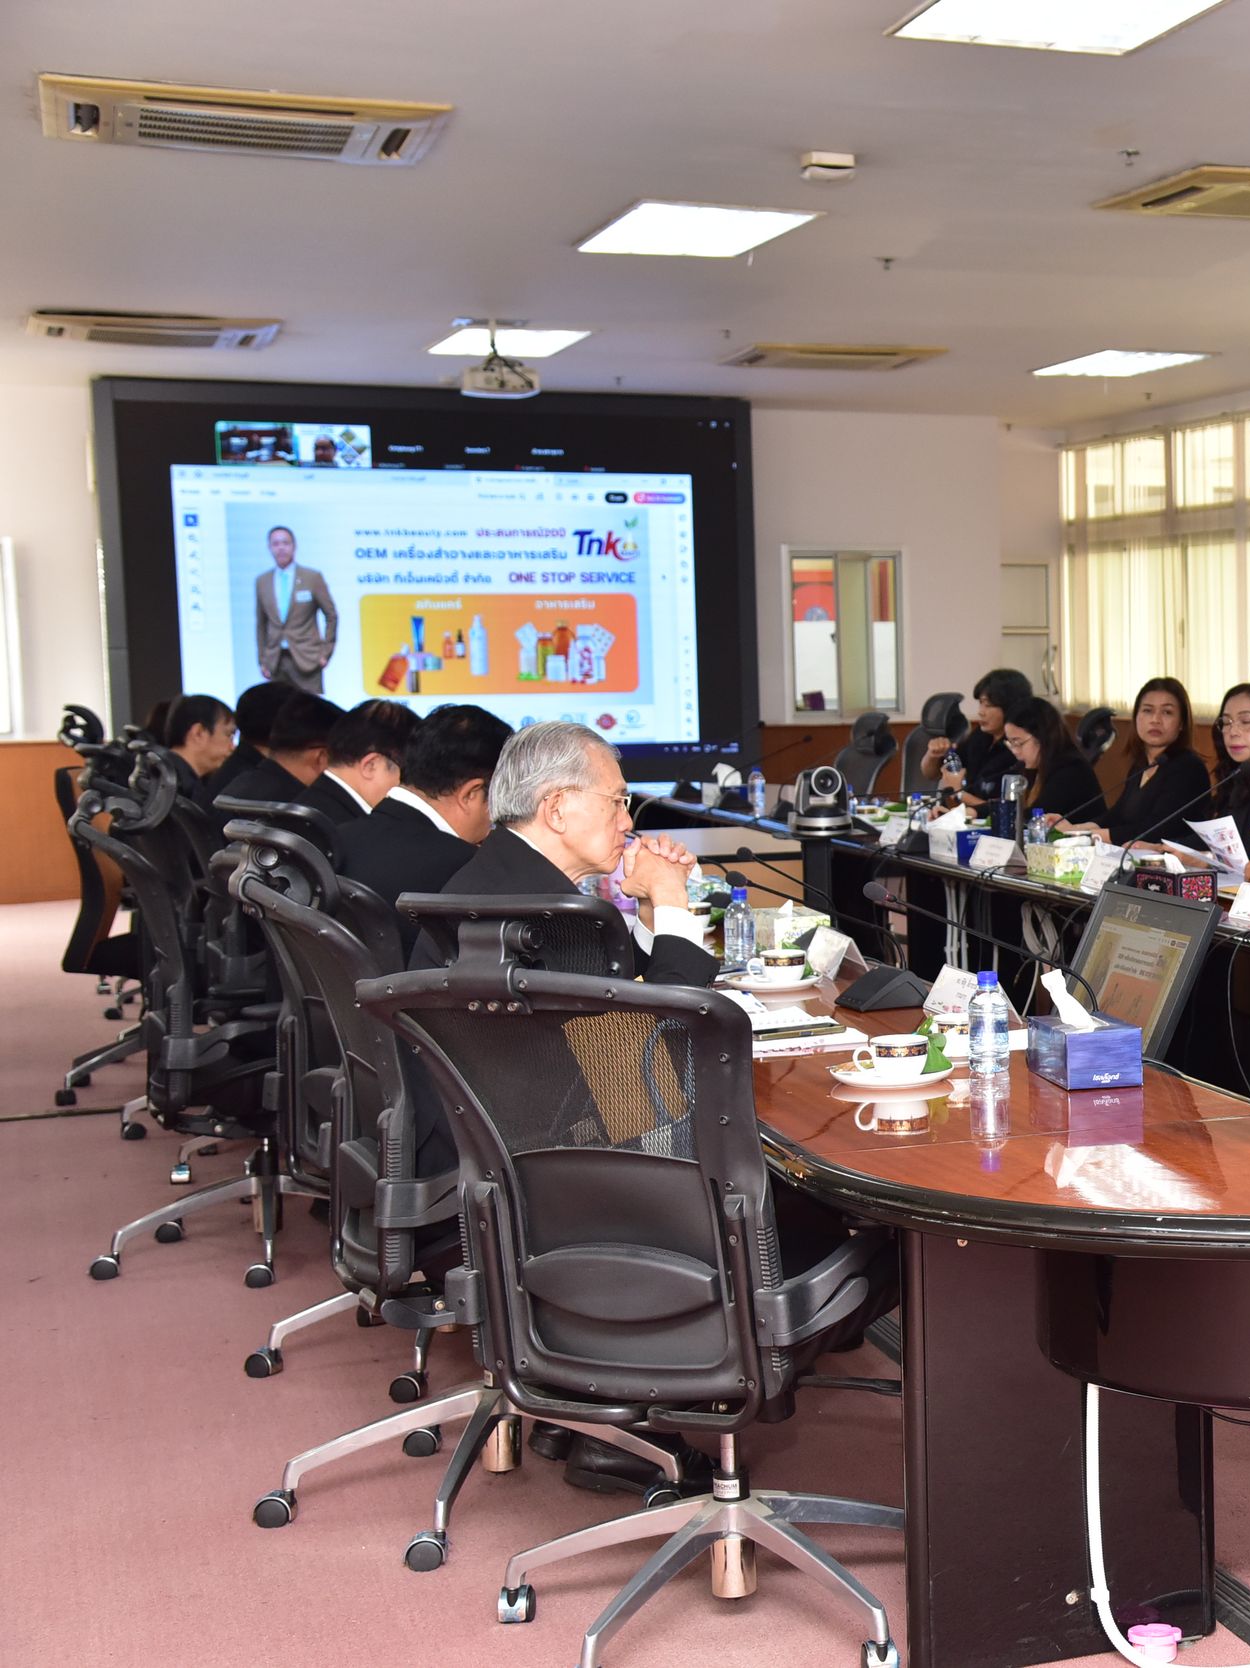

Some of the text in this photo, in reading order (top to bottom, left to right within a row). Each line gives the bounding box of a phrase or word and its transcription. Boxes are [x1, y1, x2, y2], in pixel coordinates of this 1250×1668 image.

[355, 548, 388, 558] OEM
[508, 572, 636, 583] ONE STOP SERVICE
